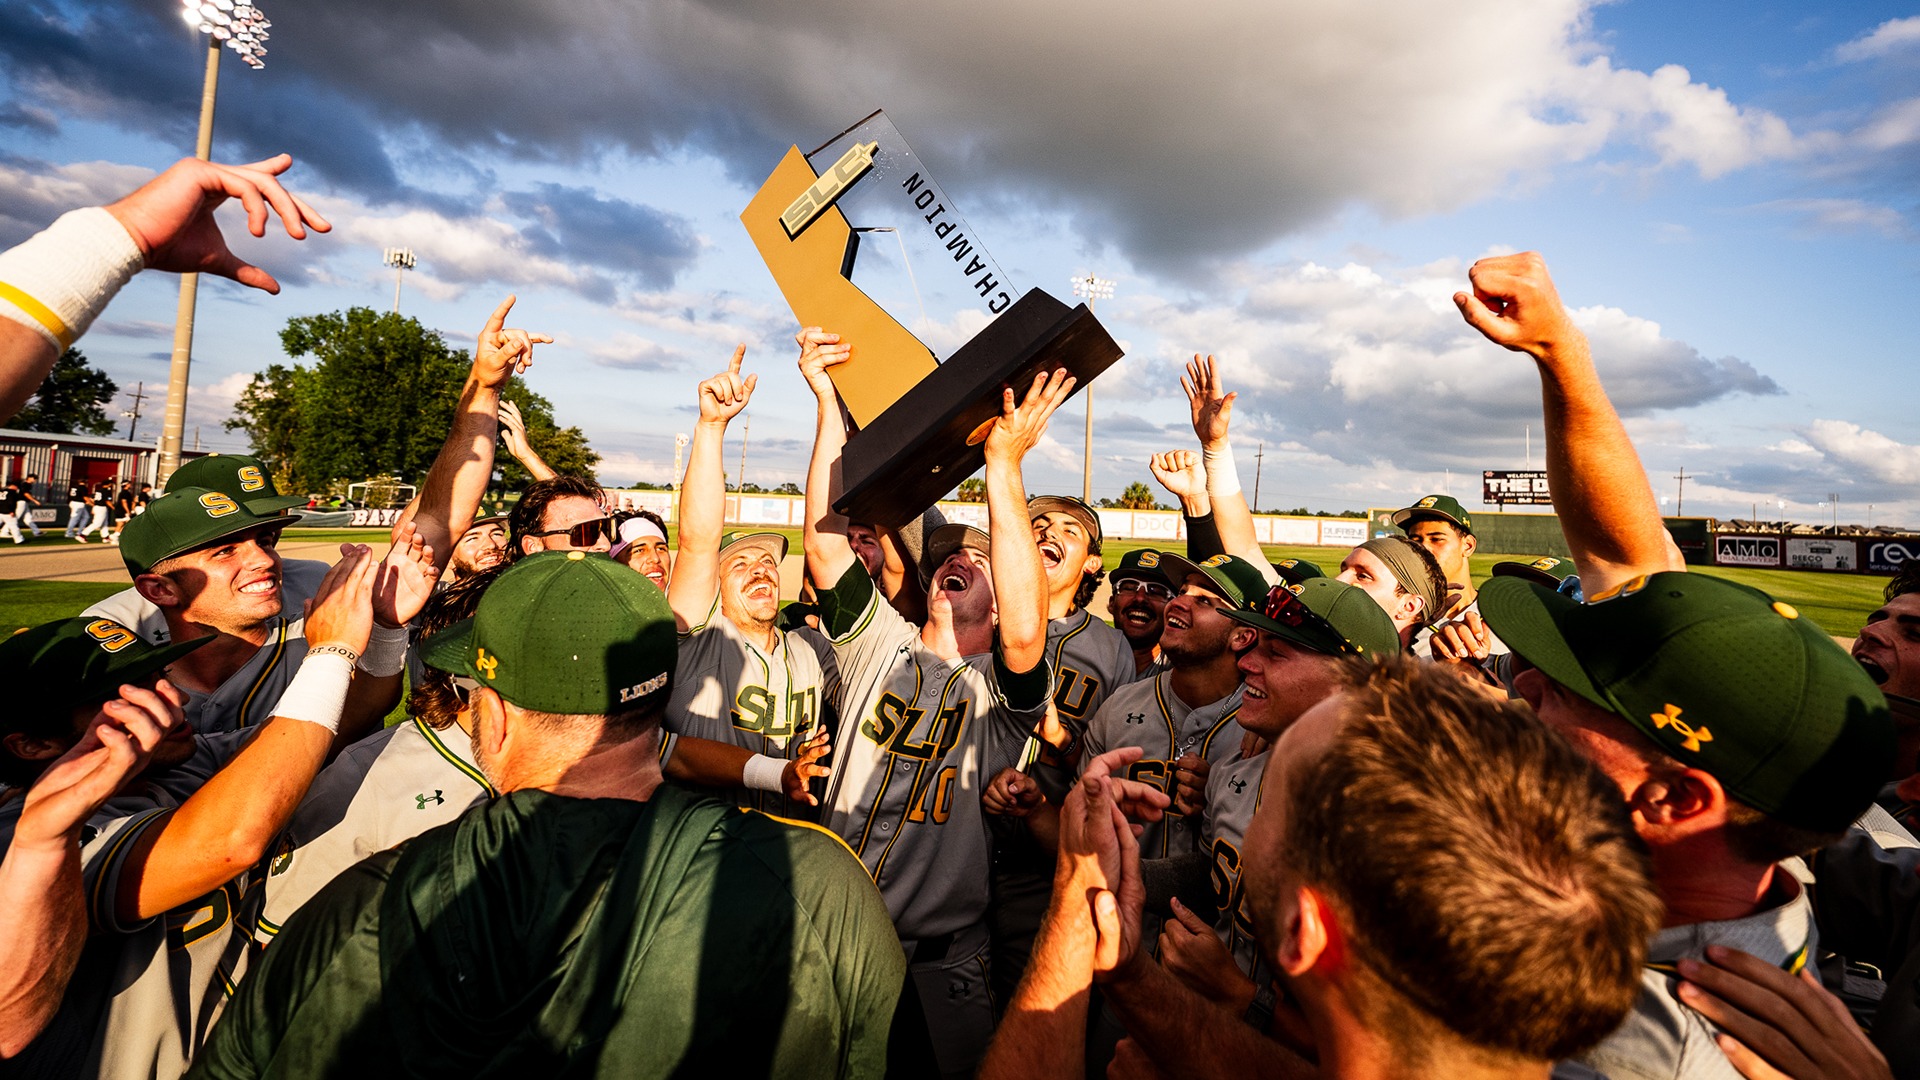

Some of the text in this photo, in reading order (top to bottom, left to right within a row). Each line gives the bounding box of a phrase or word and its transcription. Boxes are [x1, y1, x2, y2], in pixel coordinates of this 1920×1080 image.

[783, 147, 867, 232] SLC
[902, 172, 1011, 314] CHAMPION
[238, 465, 266, 493] S
[1485, 478, 1549, 492] THE D
[198, 491, 240, 518] S
[1137, 518, 1174, 531] DDC
[1323, 527, 1365, 536] DUFRENE
[1137, 551, 1161, 569] S
[1199, 554, 1233, 568] S
[1721, 544, 1775, 558] AMO
[1792, 554, 1823, 562] REECO
[1530, 557, 1561, 571] S
[85, 619, 138, 653] S
[327, 646, 356, 660] GOD
[620, 671, 668, 703] LIONS
[730, 684, 818, 737] SLU
[861, 690, 971, 762] SLU
[907, 765, 958, 825] 10
